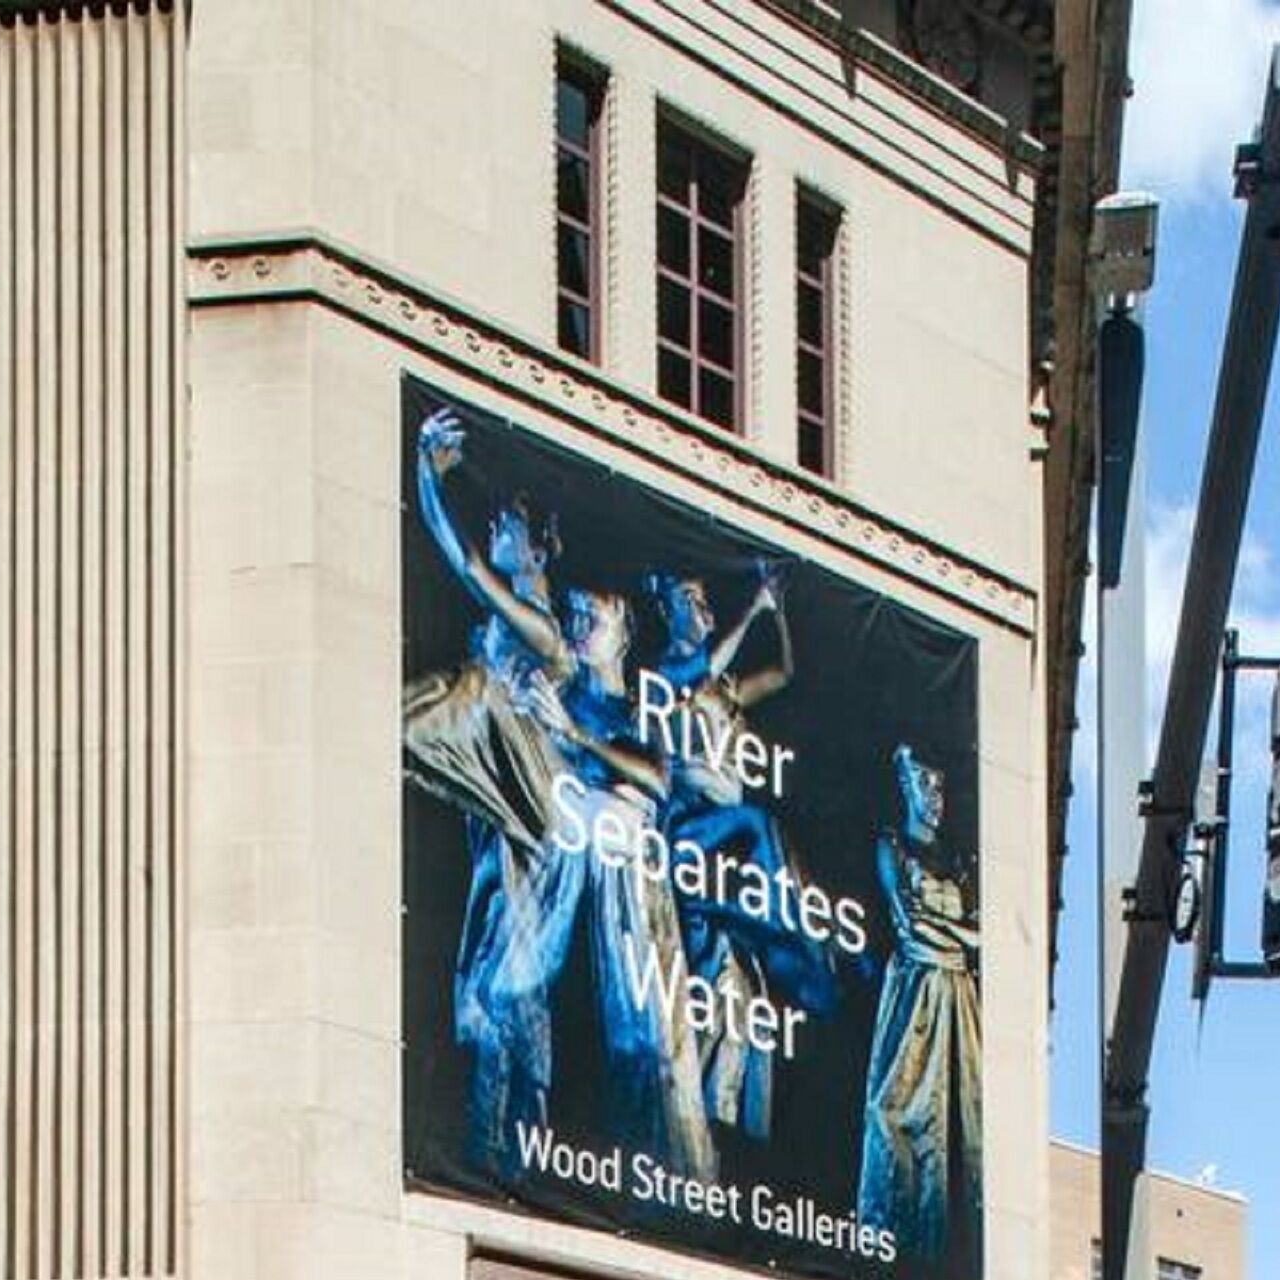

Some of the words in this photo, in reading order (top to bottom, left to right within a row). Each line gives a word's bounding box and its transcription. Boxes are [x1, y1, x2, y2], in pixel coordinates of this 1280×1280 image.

[638, 668, 795, 798] River
[551, 773, 866, 953] Separates
[623, 931, 807, 1060] Water
[516, 1122, 622, 1192] Wood
[632, 1152, 741, 1224] Street
[752, 1185, 897, 1264] Galleries
